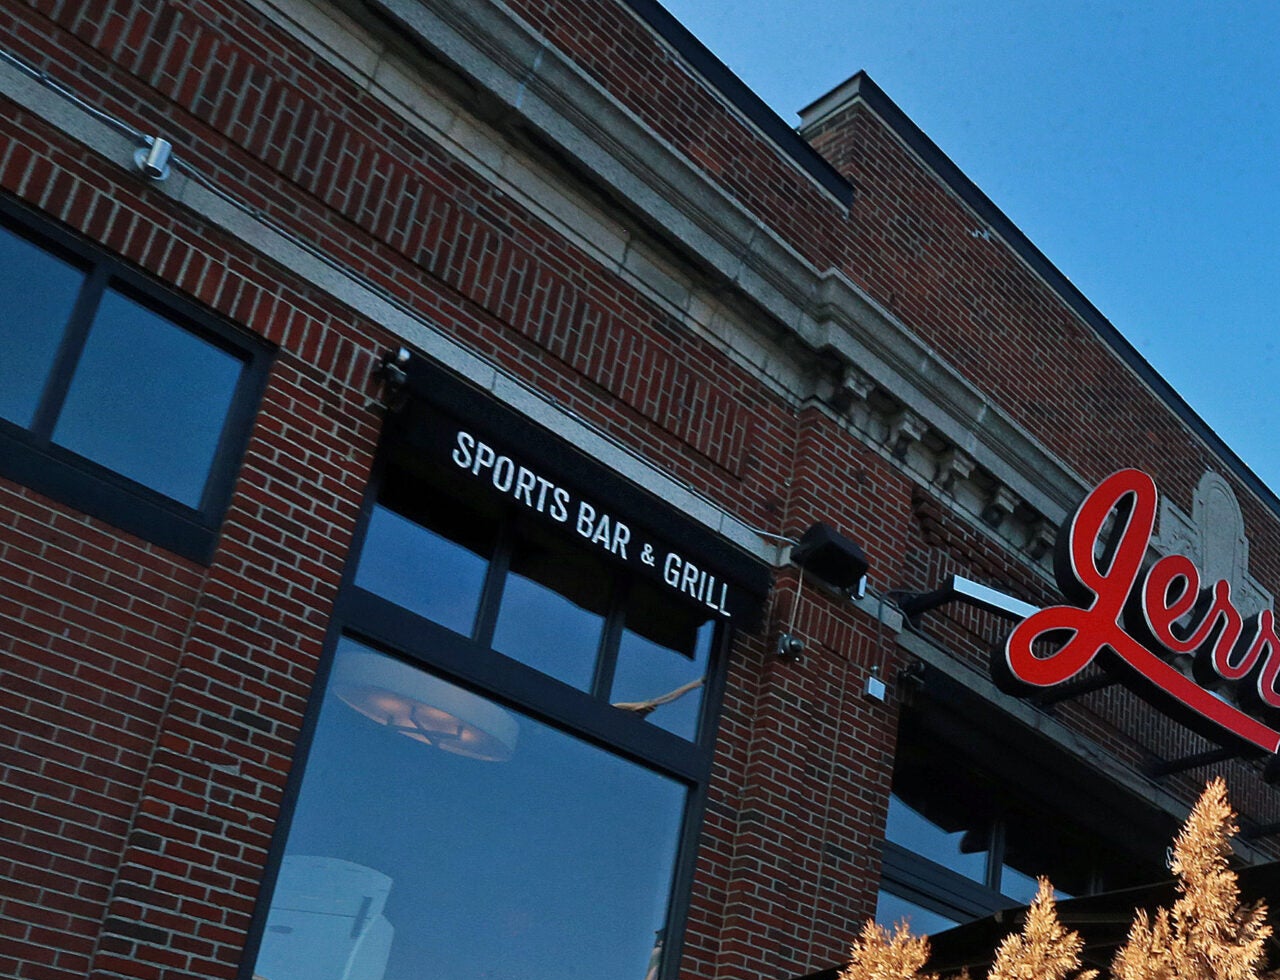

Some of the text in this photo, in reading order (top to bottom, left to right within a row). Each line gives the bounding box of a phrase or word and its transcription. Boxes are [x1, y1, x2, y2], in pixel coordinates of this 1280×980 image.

[452, 430, 731, 617] SPORTS BAR & GRILL
